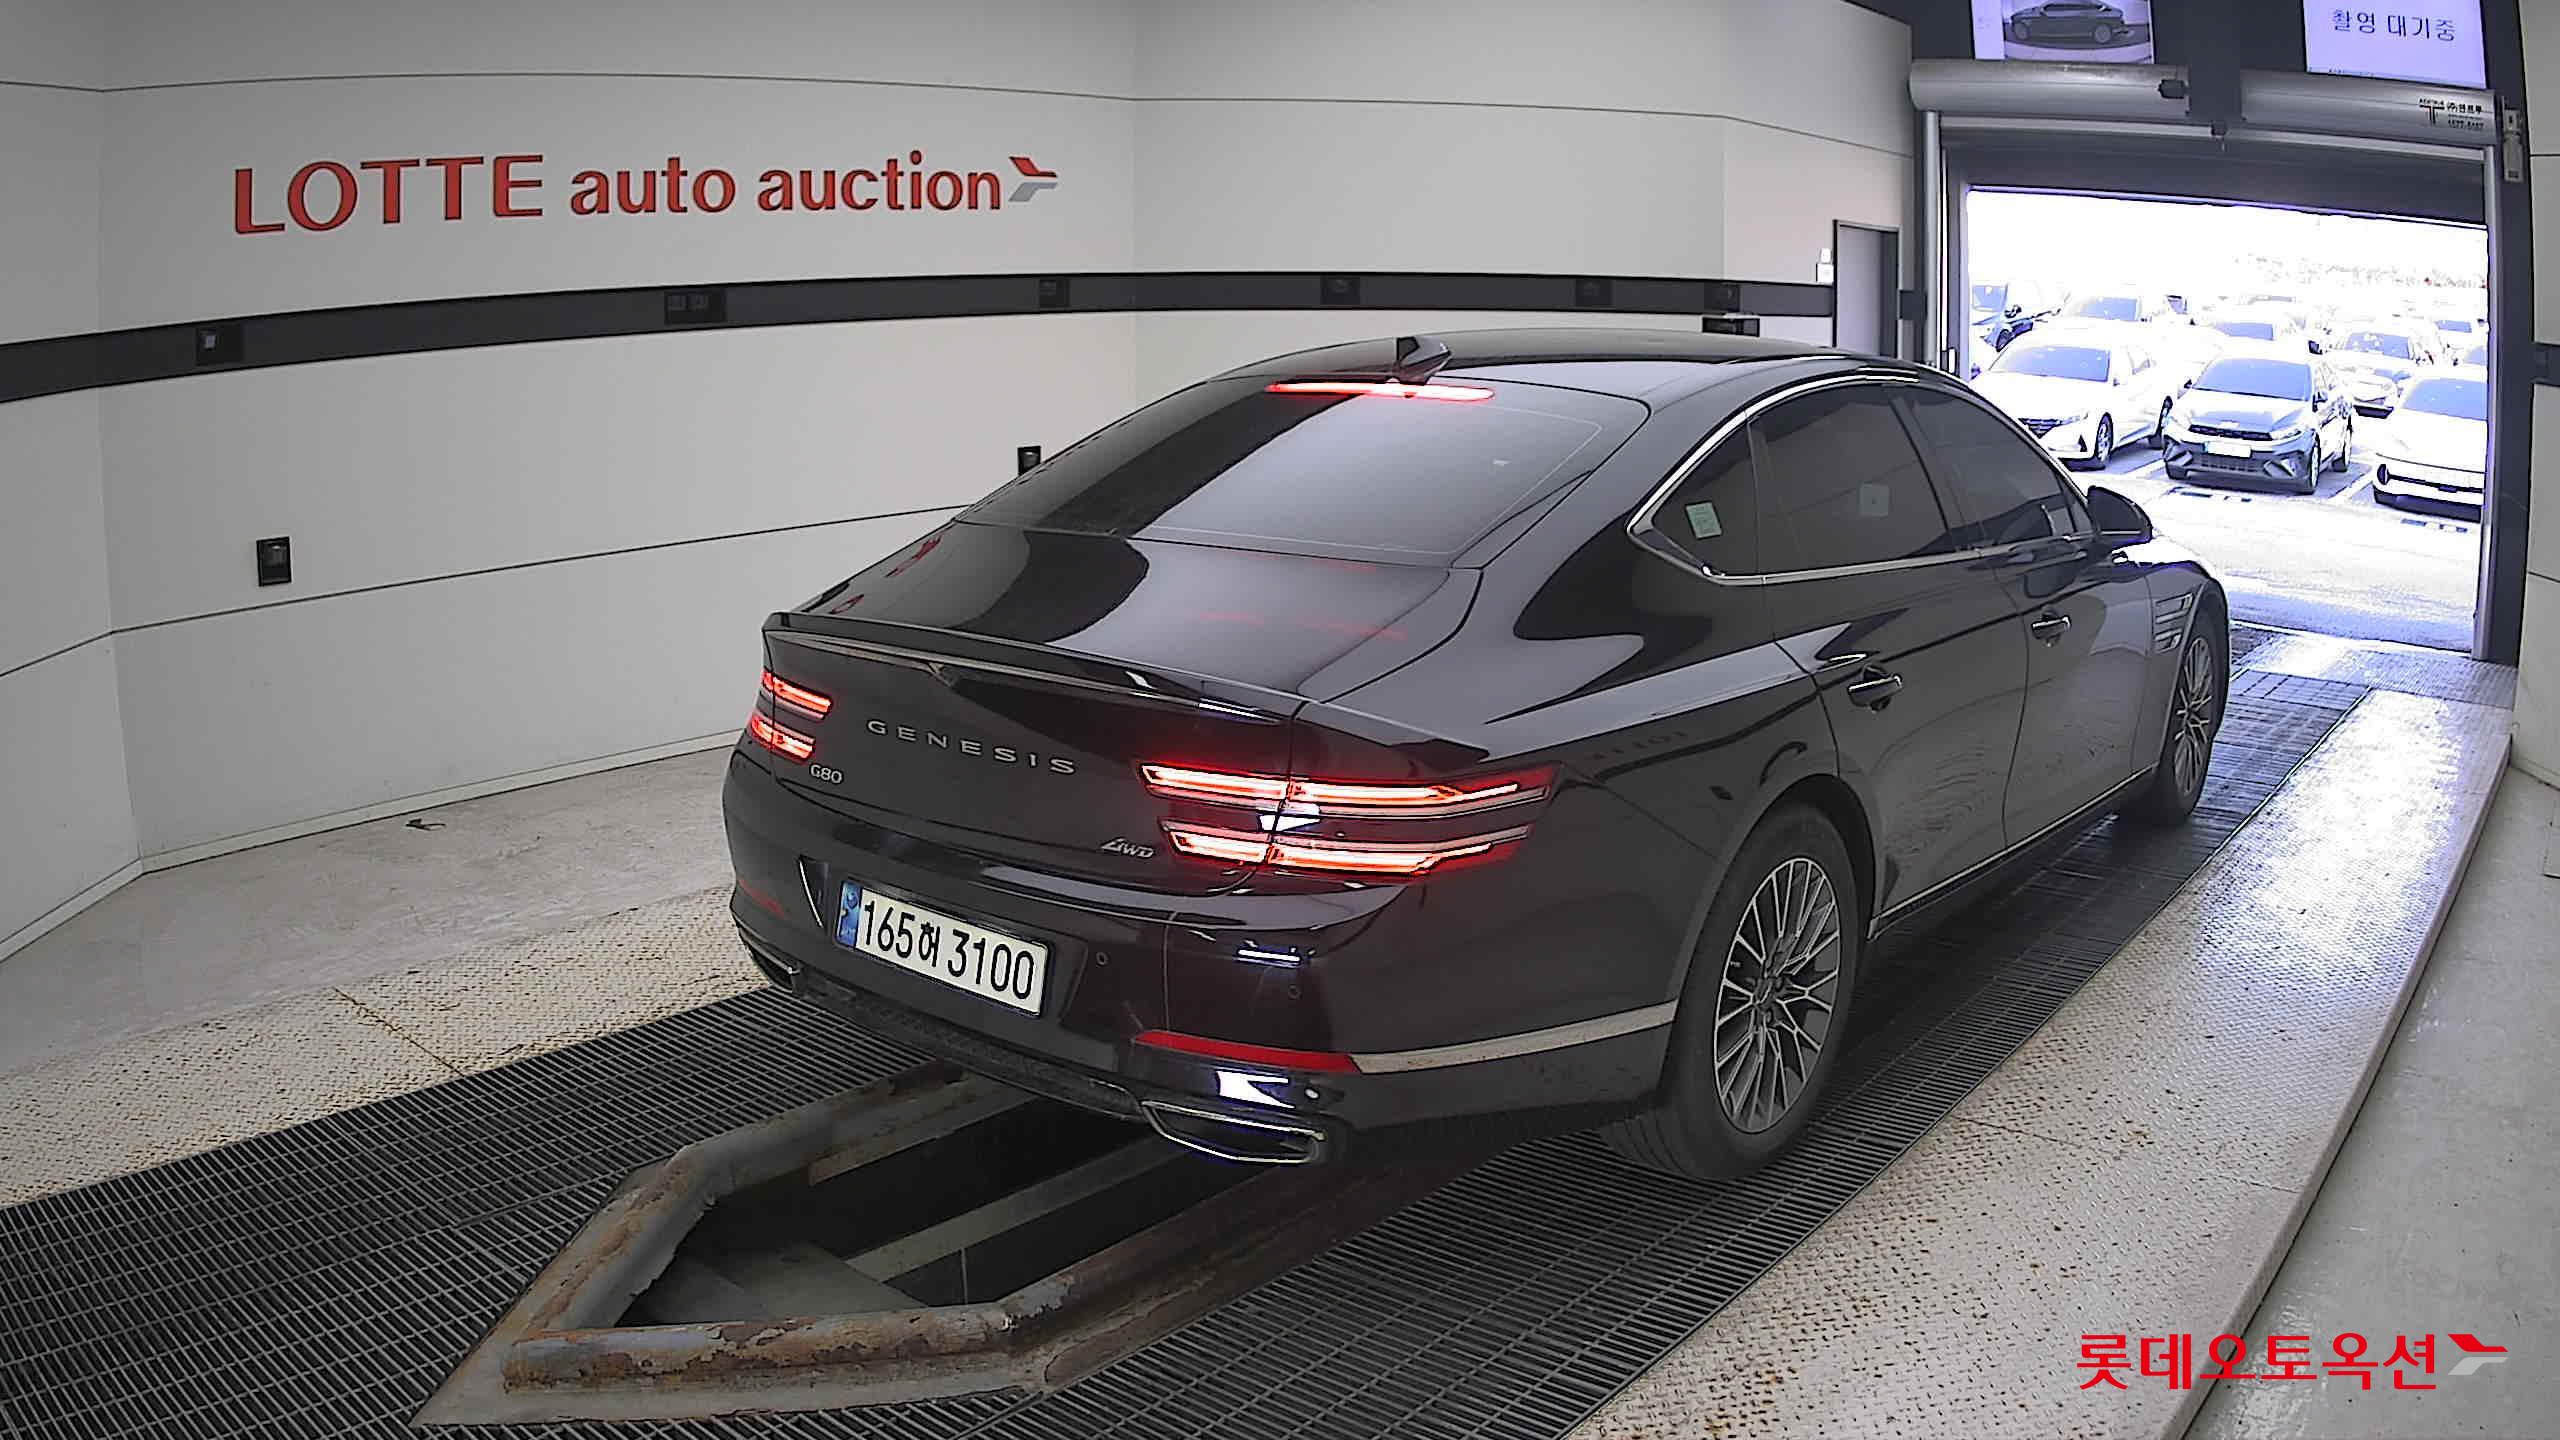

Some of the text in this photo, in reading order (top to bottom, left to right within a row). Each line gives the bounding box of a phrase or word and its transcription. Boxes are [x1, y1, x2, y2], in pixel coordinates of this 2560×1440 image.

[2387, 14, 2456, 43] 대기중
[234, 149, 1002, 235] LOTTE auto auction
[809, 763, 844, 785] G80
[867, 719, 1076, 776] GENESIS
[946, 929, 1035, 1000] 3100
